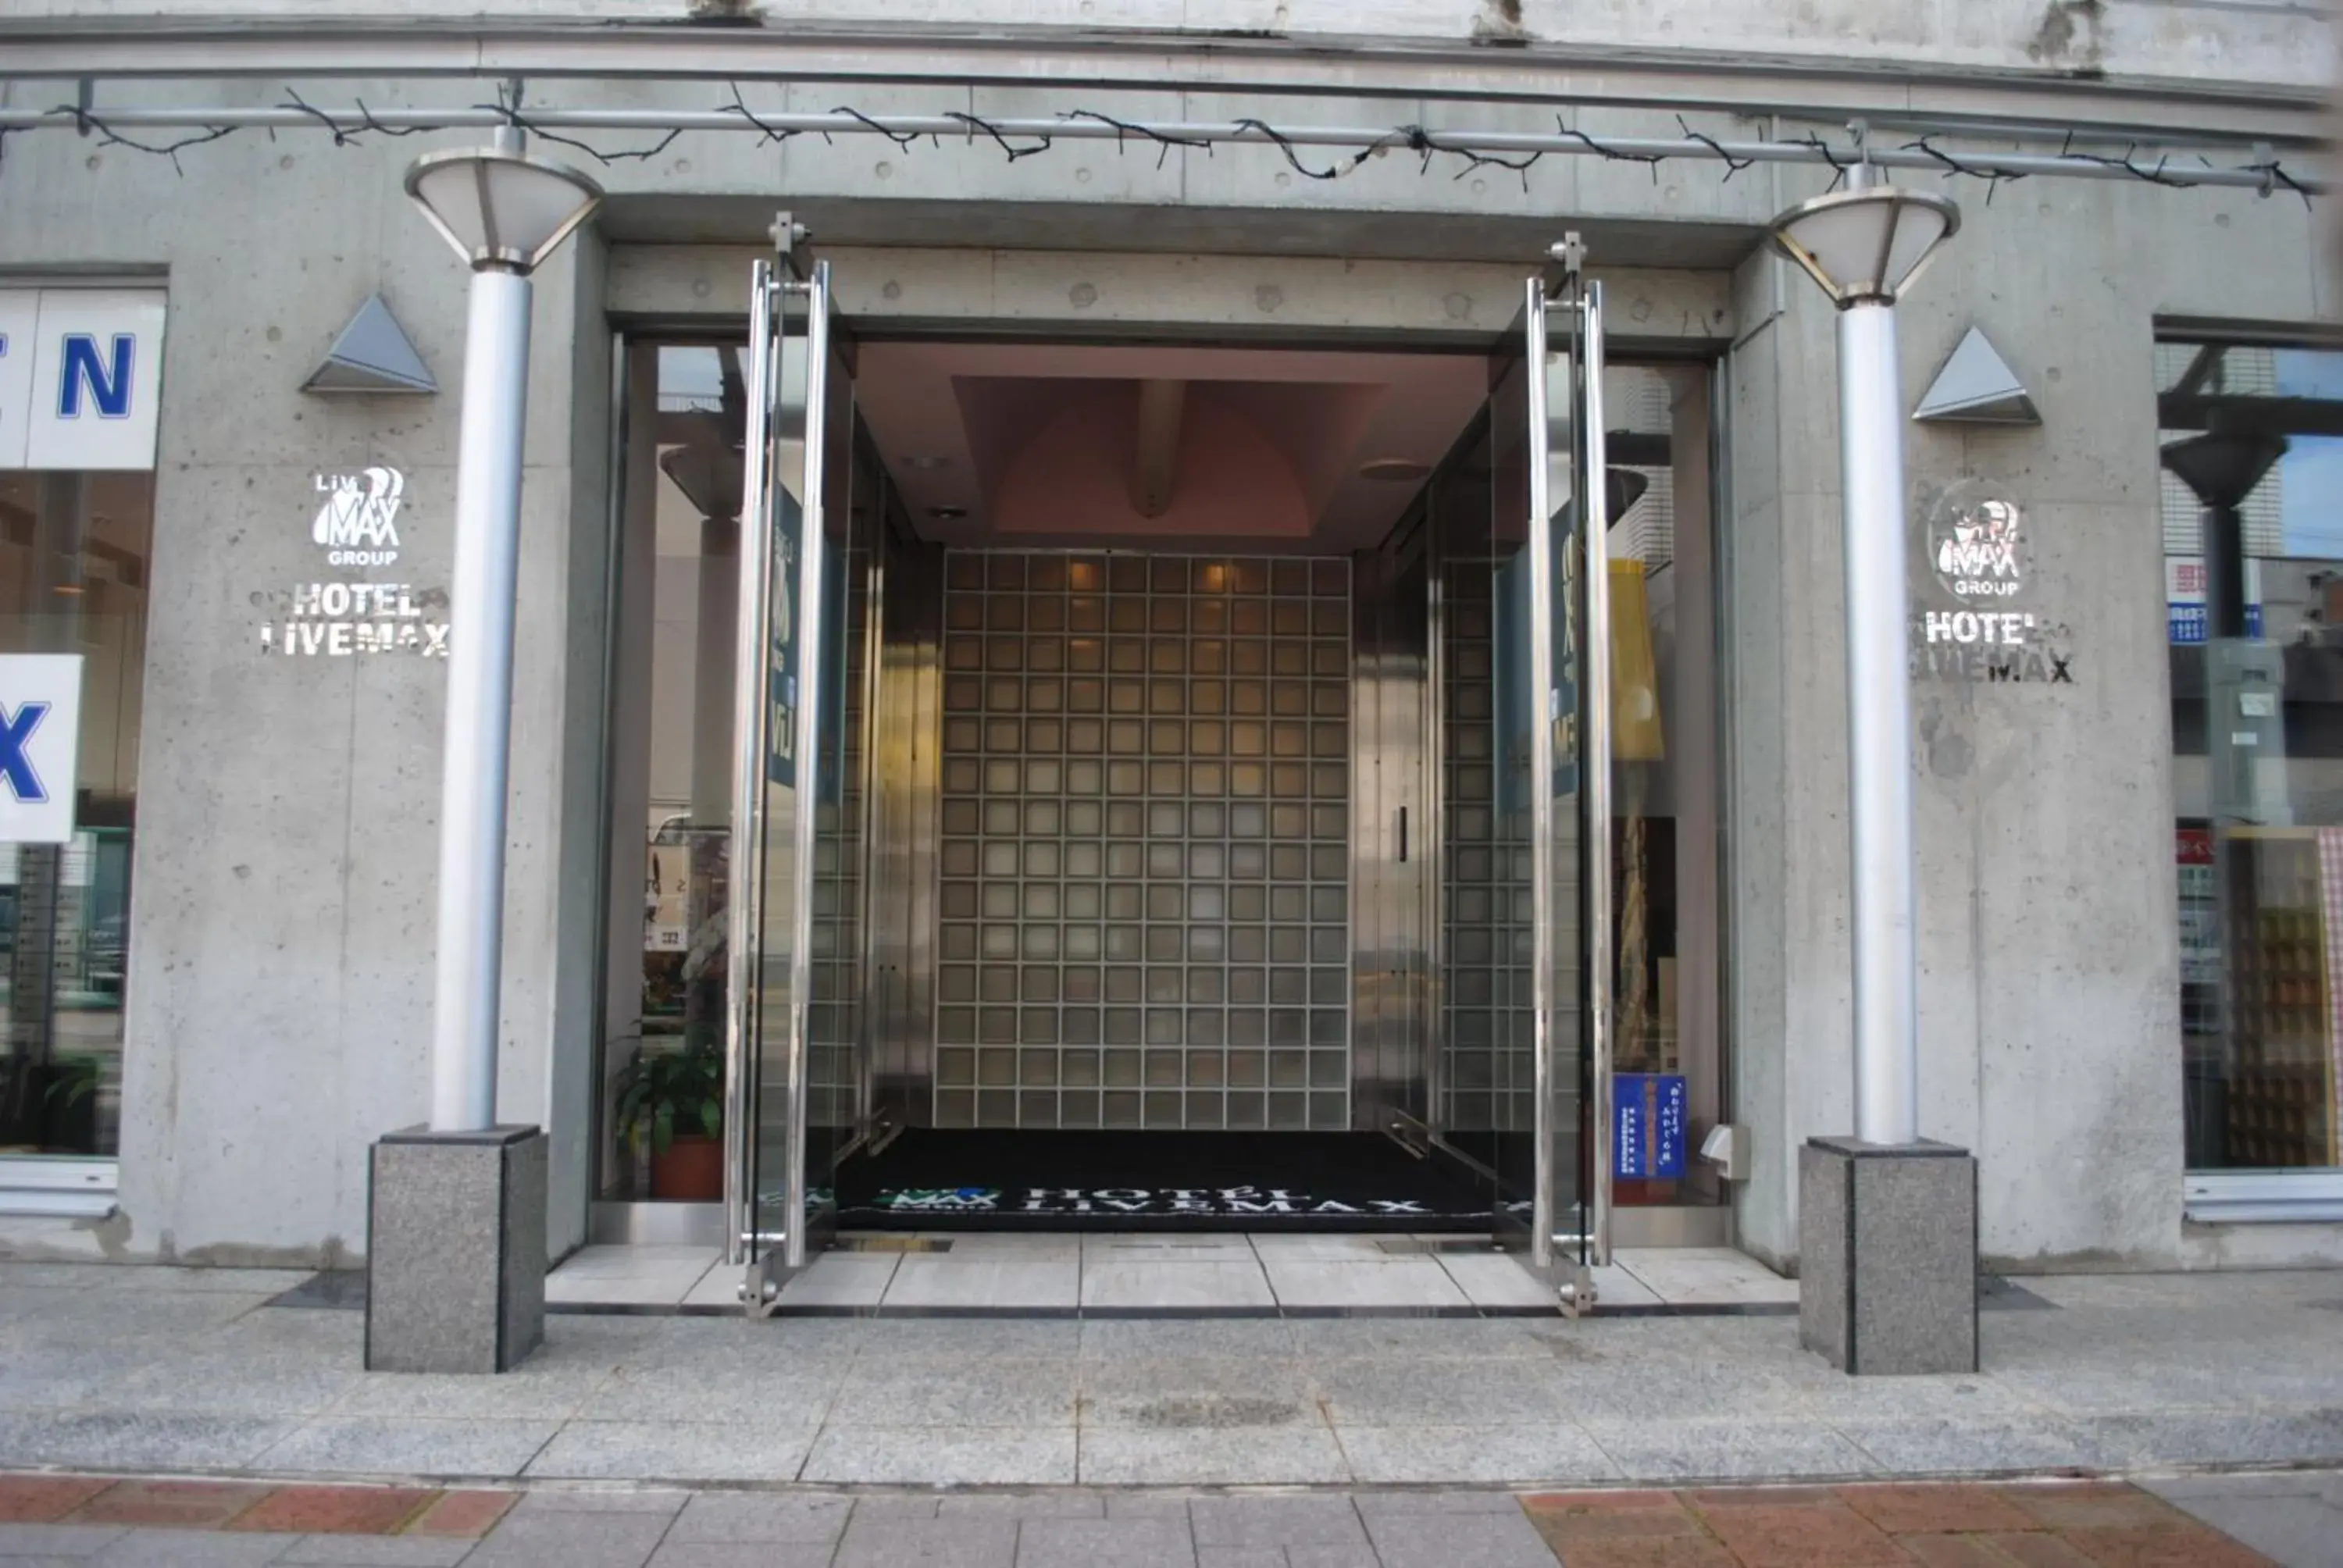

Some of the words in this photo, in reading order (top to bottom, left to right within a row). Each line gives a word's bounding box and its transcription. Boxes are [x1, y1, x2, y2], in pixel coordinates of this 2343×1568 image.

[0, 333, 136, 419] N
[328, 550, 398, 565] GROUP
[294, 583, 421, 616] HOTEL
[1955, 580, 2019, 596] GROUP
